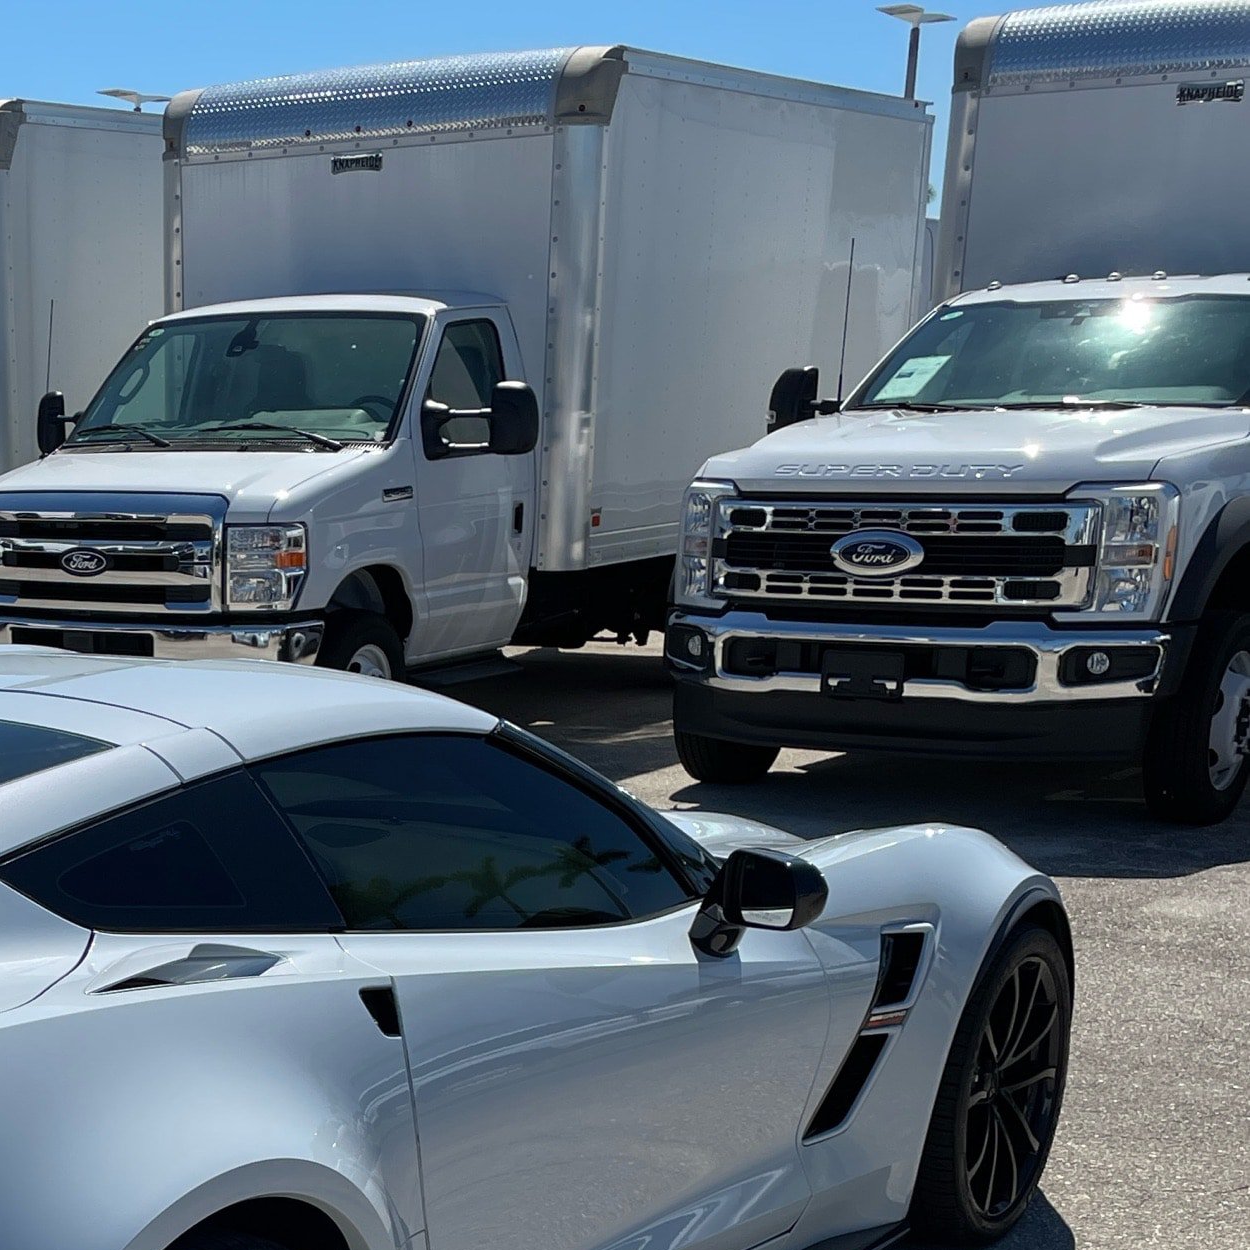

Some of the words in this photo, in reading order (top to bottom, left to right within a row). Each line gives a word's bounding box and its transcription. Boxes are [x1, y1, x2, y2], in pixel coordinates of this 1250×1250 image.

[1178, 84, 1243, 102] KNAPHEIDE
[333, 156, 381, 172] KNAPHEIDE
[774, 463, 903, 478] SUPER
[909, 463, 1025, 478] DUTY
[69, 554, 98, 569] Ford
[851, 543, 895, 565] Ford
